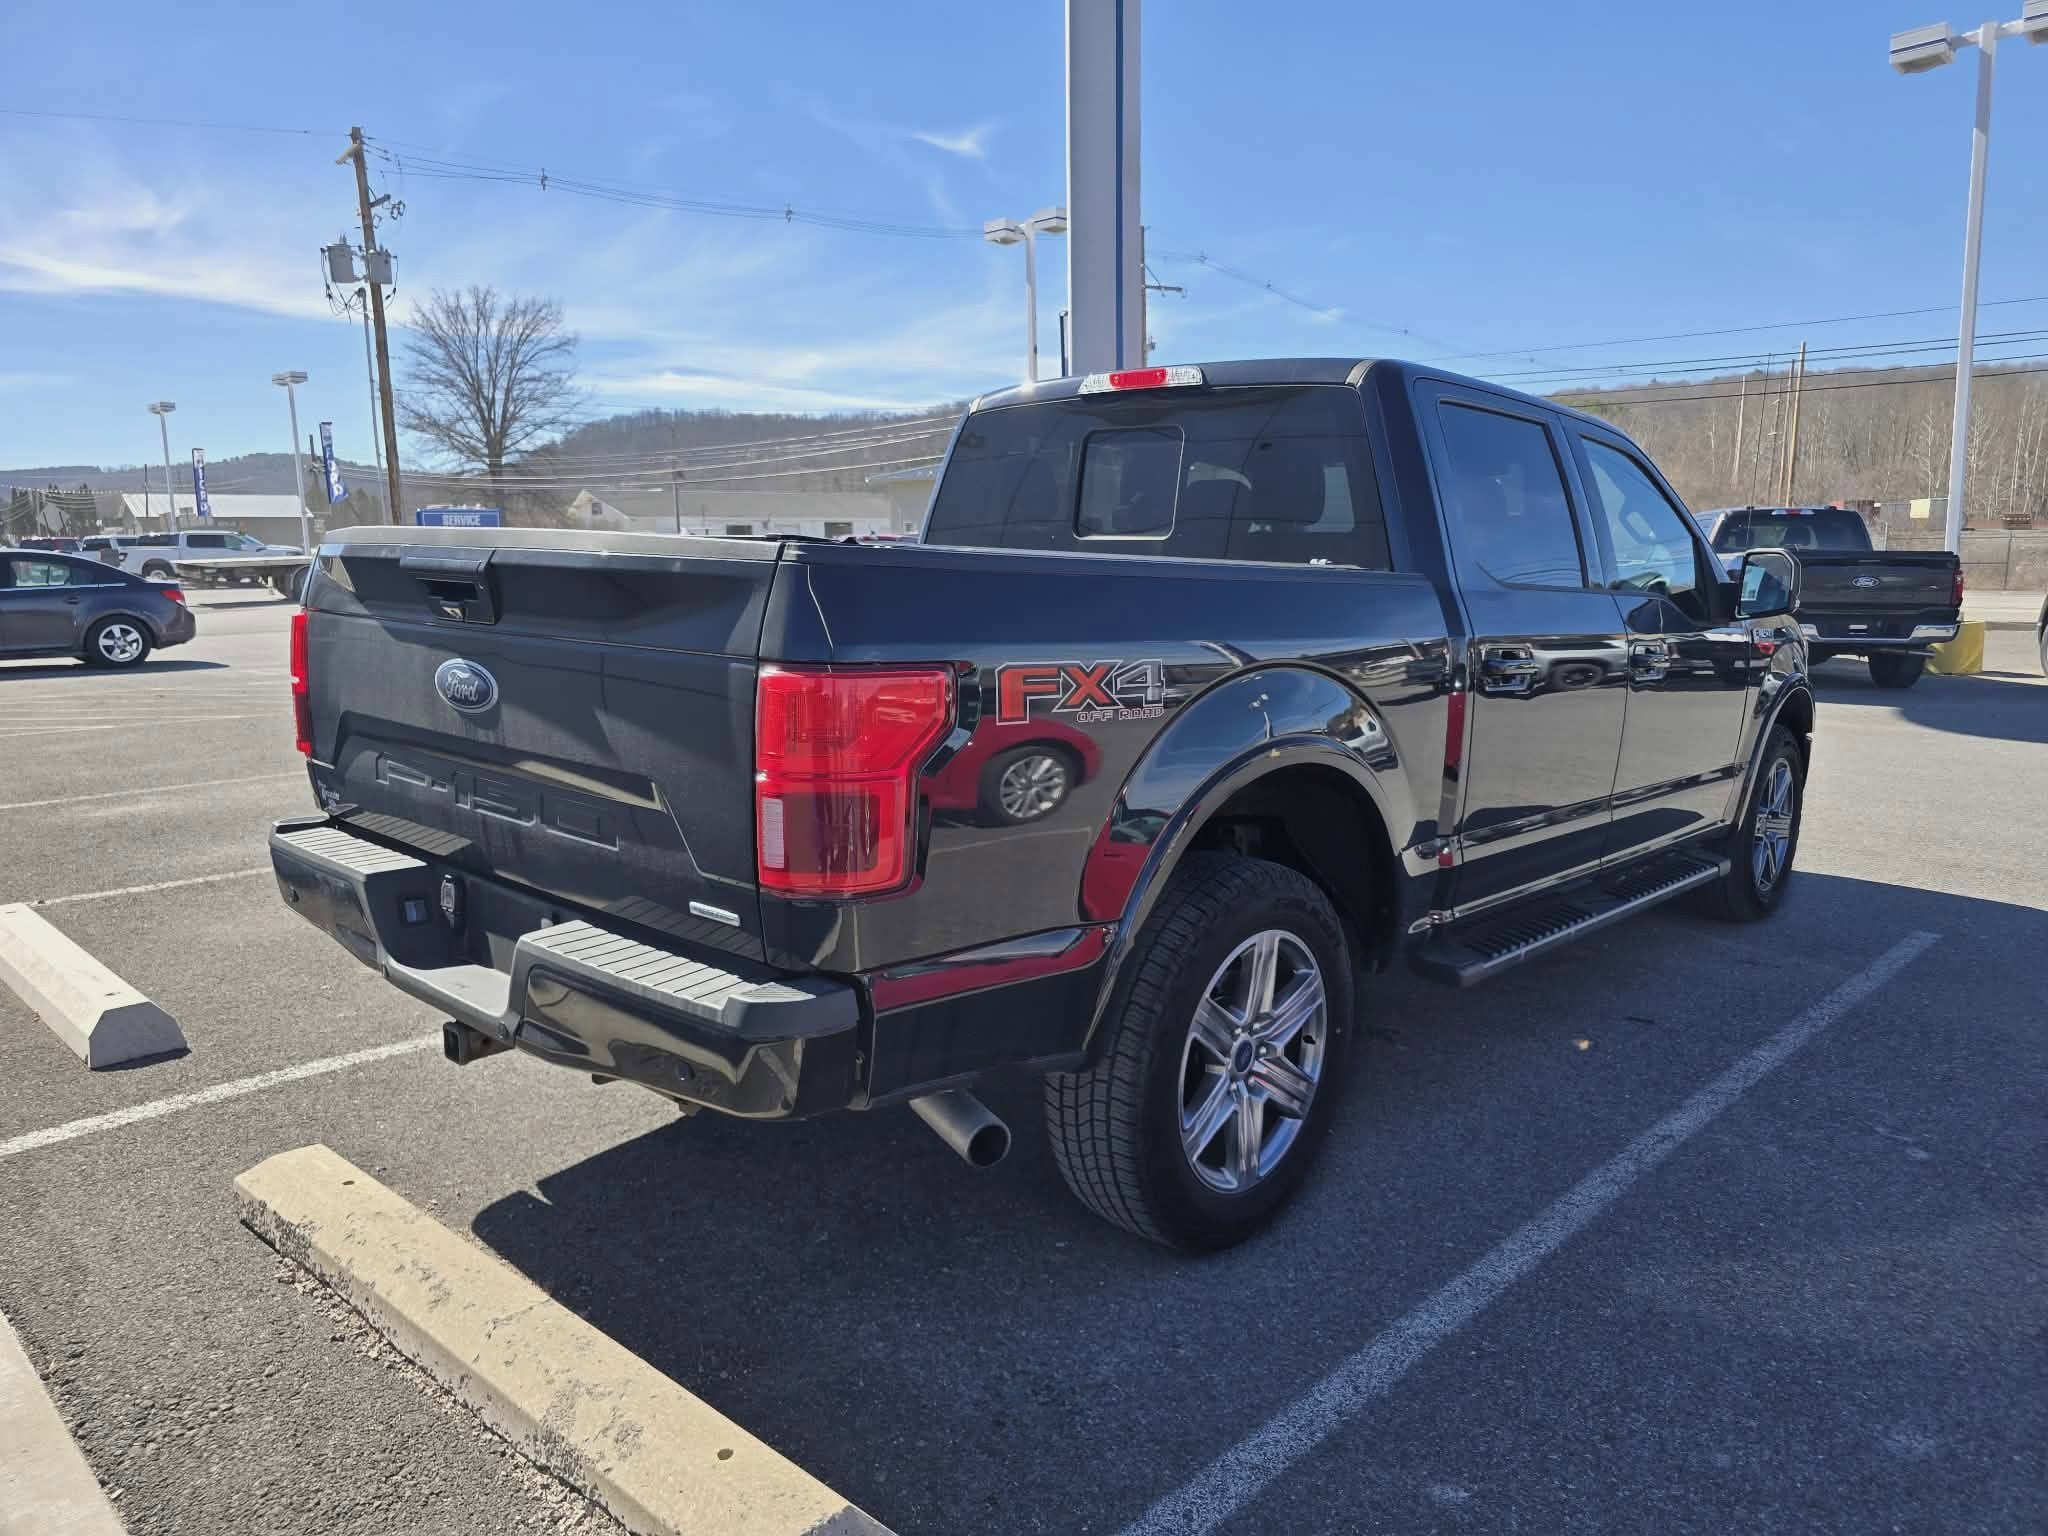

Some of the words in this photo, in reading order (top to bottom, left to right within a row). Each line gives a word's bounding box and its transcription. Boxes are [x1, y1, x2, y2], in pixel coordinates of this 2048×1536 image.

[442, 514, 481, 527] SERVICE
[995, 658, 1166, 726] FX4
[1076, 709, 1114, 723] OFF
[1118, 706, 1166, 721] ROAD
